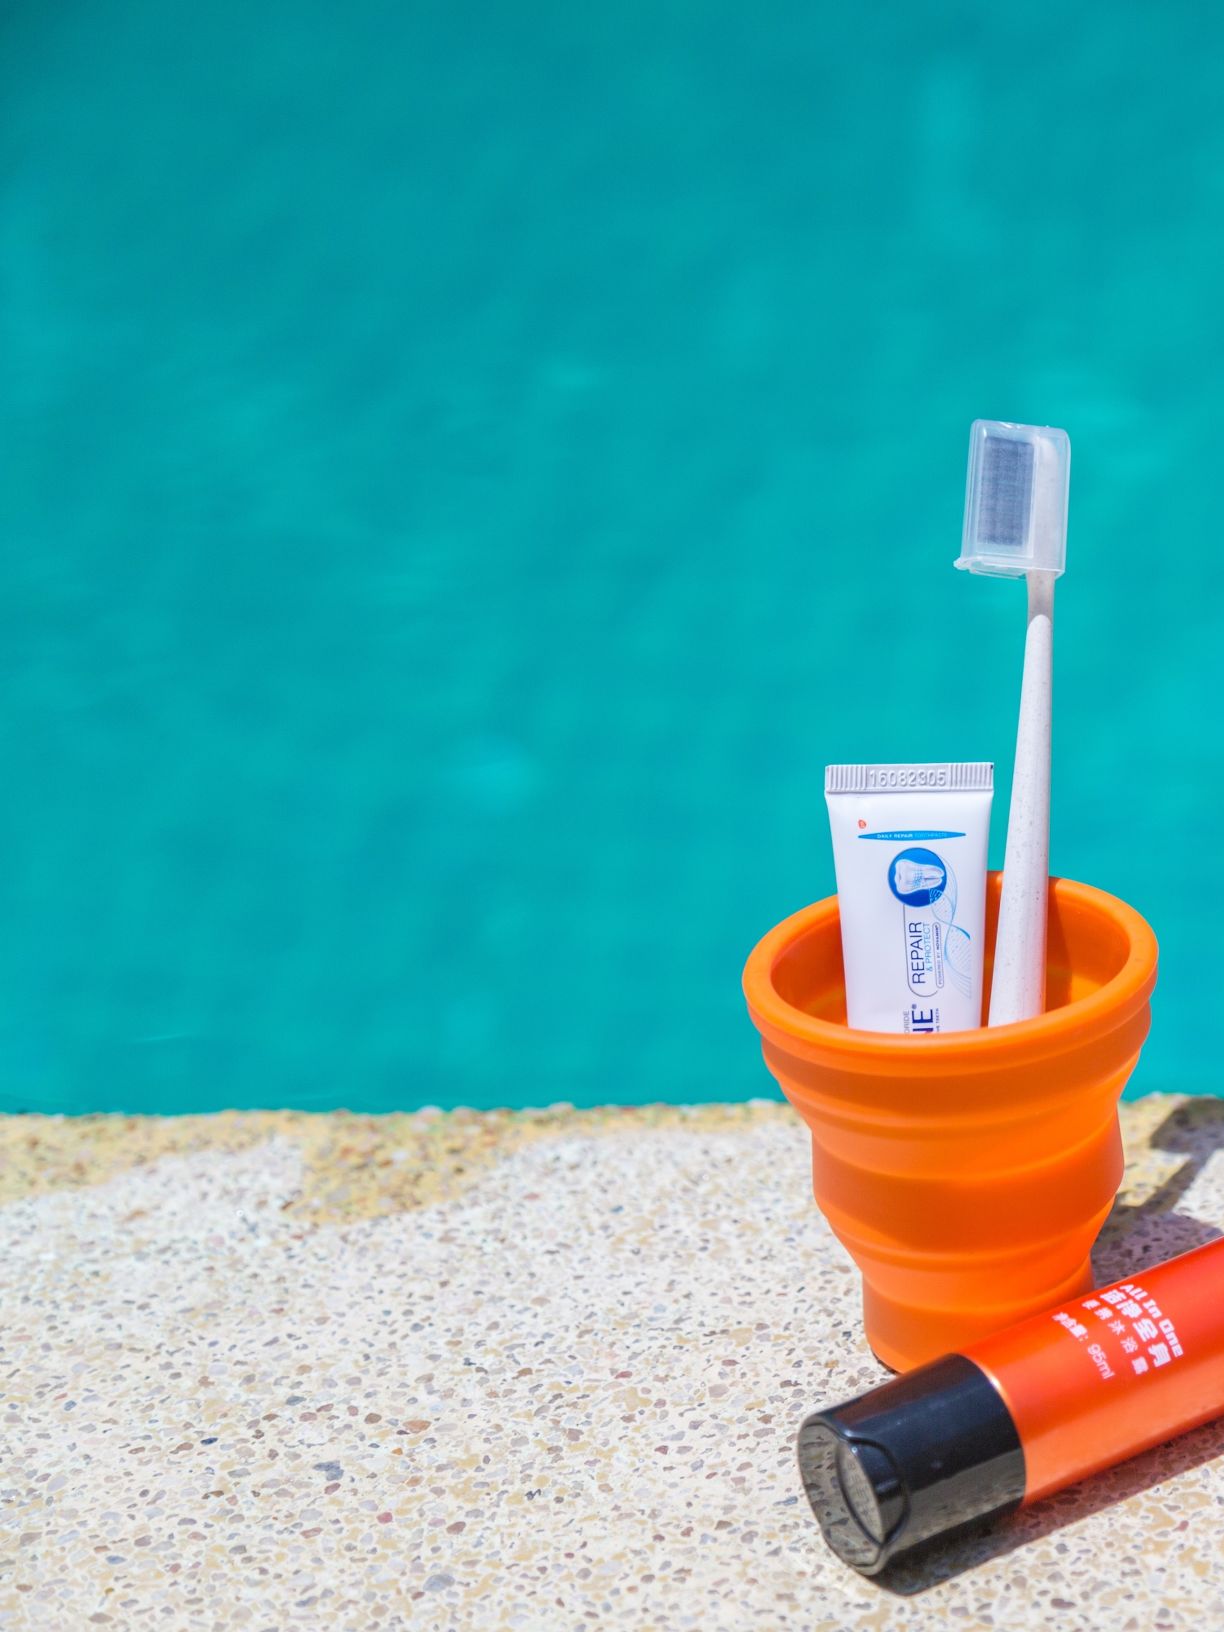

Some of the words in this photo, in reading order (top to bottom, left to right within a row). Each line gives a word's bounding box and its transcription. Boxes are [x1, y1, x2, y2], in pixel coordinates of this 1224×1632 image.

[869, 769, 947, 787] 16082305
[909, 922, 926, 984] REPAIR
[923, 923, 931, 963] PROTECT
[1119, 1284, 1148, 1300] All
[1142, 1299, 1162, 1319] In
[1158, 1318, 1184, 1358] One
[1087, 1343, 1115, 1380] 95ml
